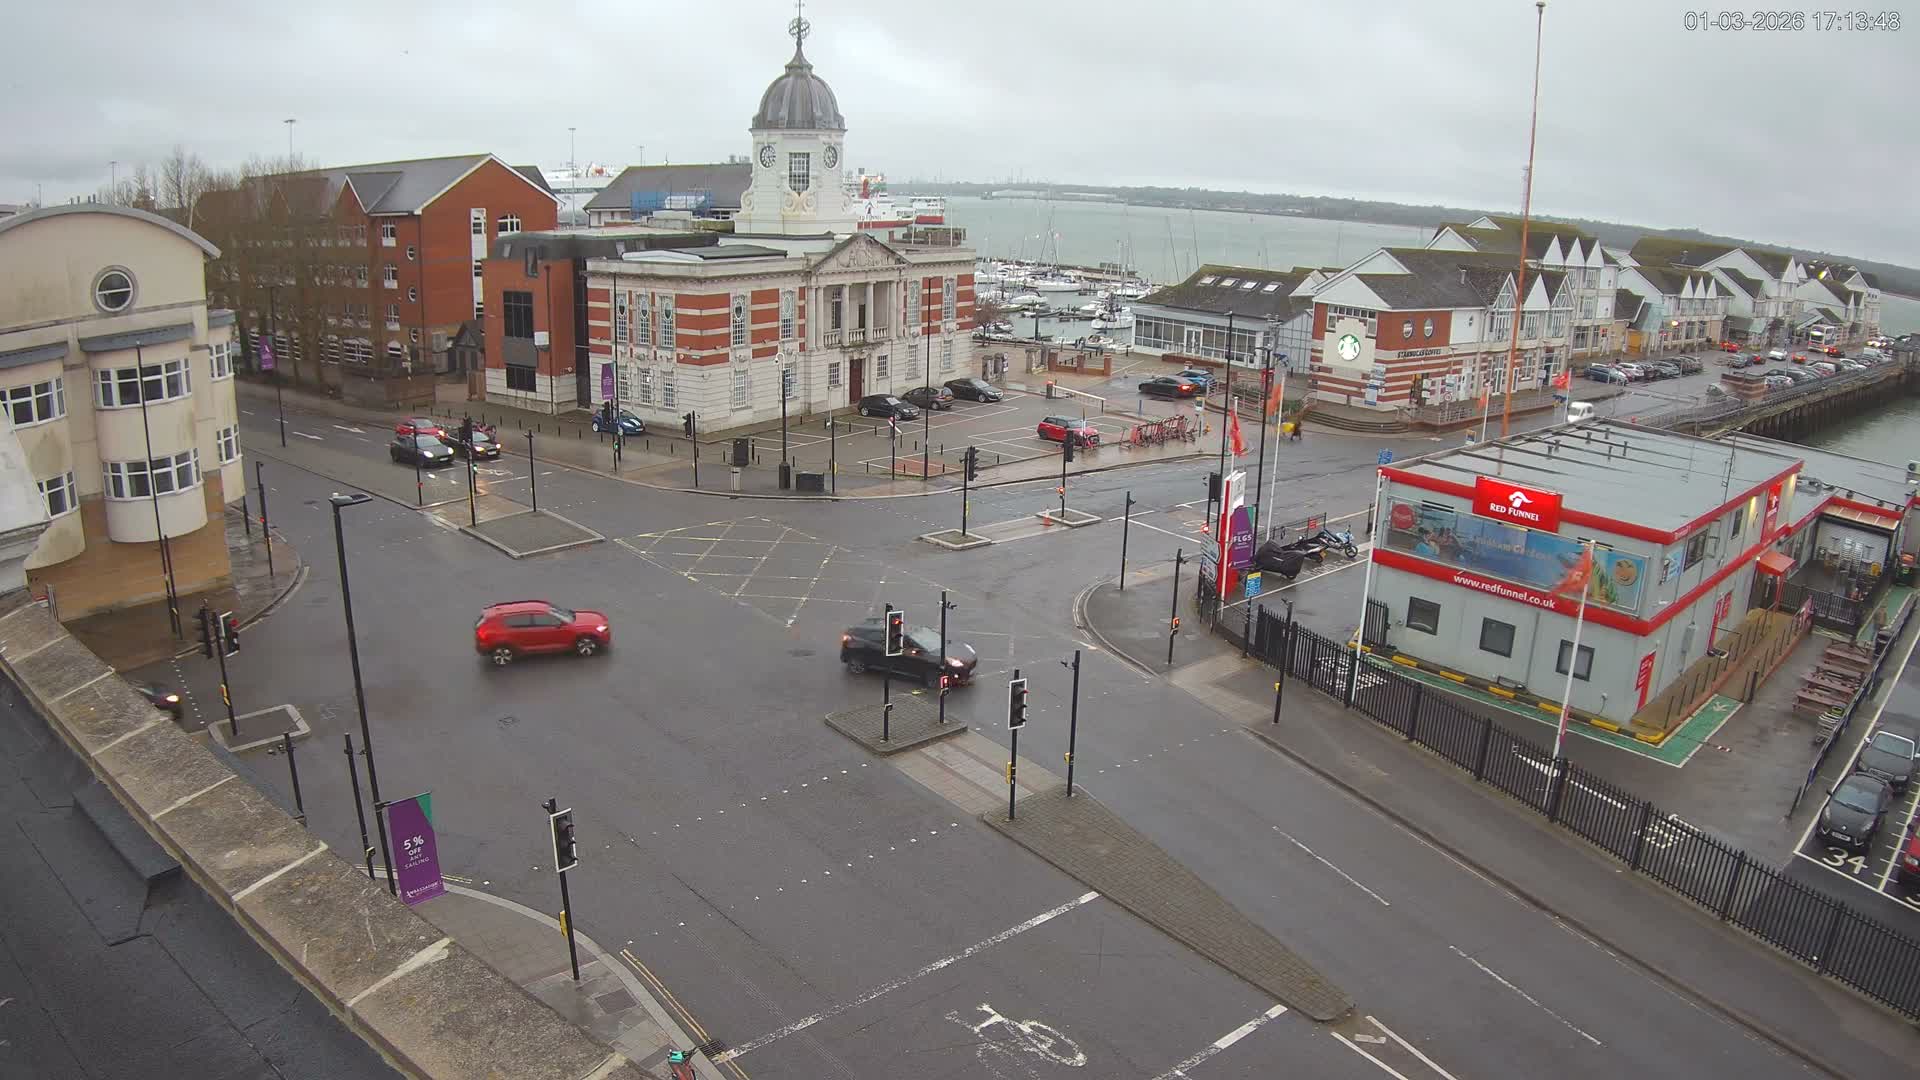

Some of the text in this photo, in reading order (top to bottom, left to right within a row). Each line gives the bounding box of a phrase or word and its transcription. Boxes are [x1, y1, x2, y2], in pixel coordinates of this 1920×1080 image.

[1489, 502, 1540, 521] RED FUNNEL
[1453, 575, 1556, 609] www.redfunnel.co.uk
[408, 847, 421, 856] OFF
[410, 853, 422, 861] ANY
[404, 856, 430, 869] SAILING
[1822, 846, 1868, 875] 34
